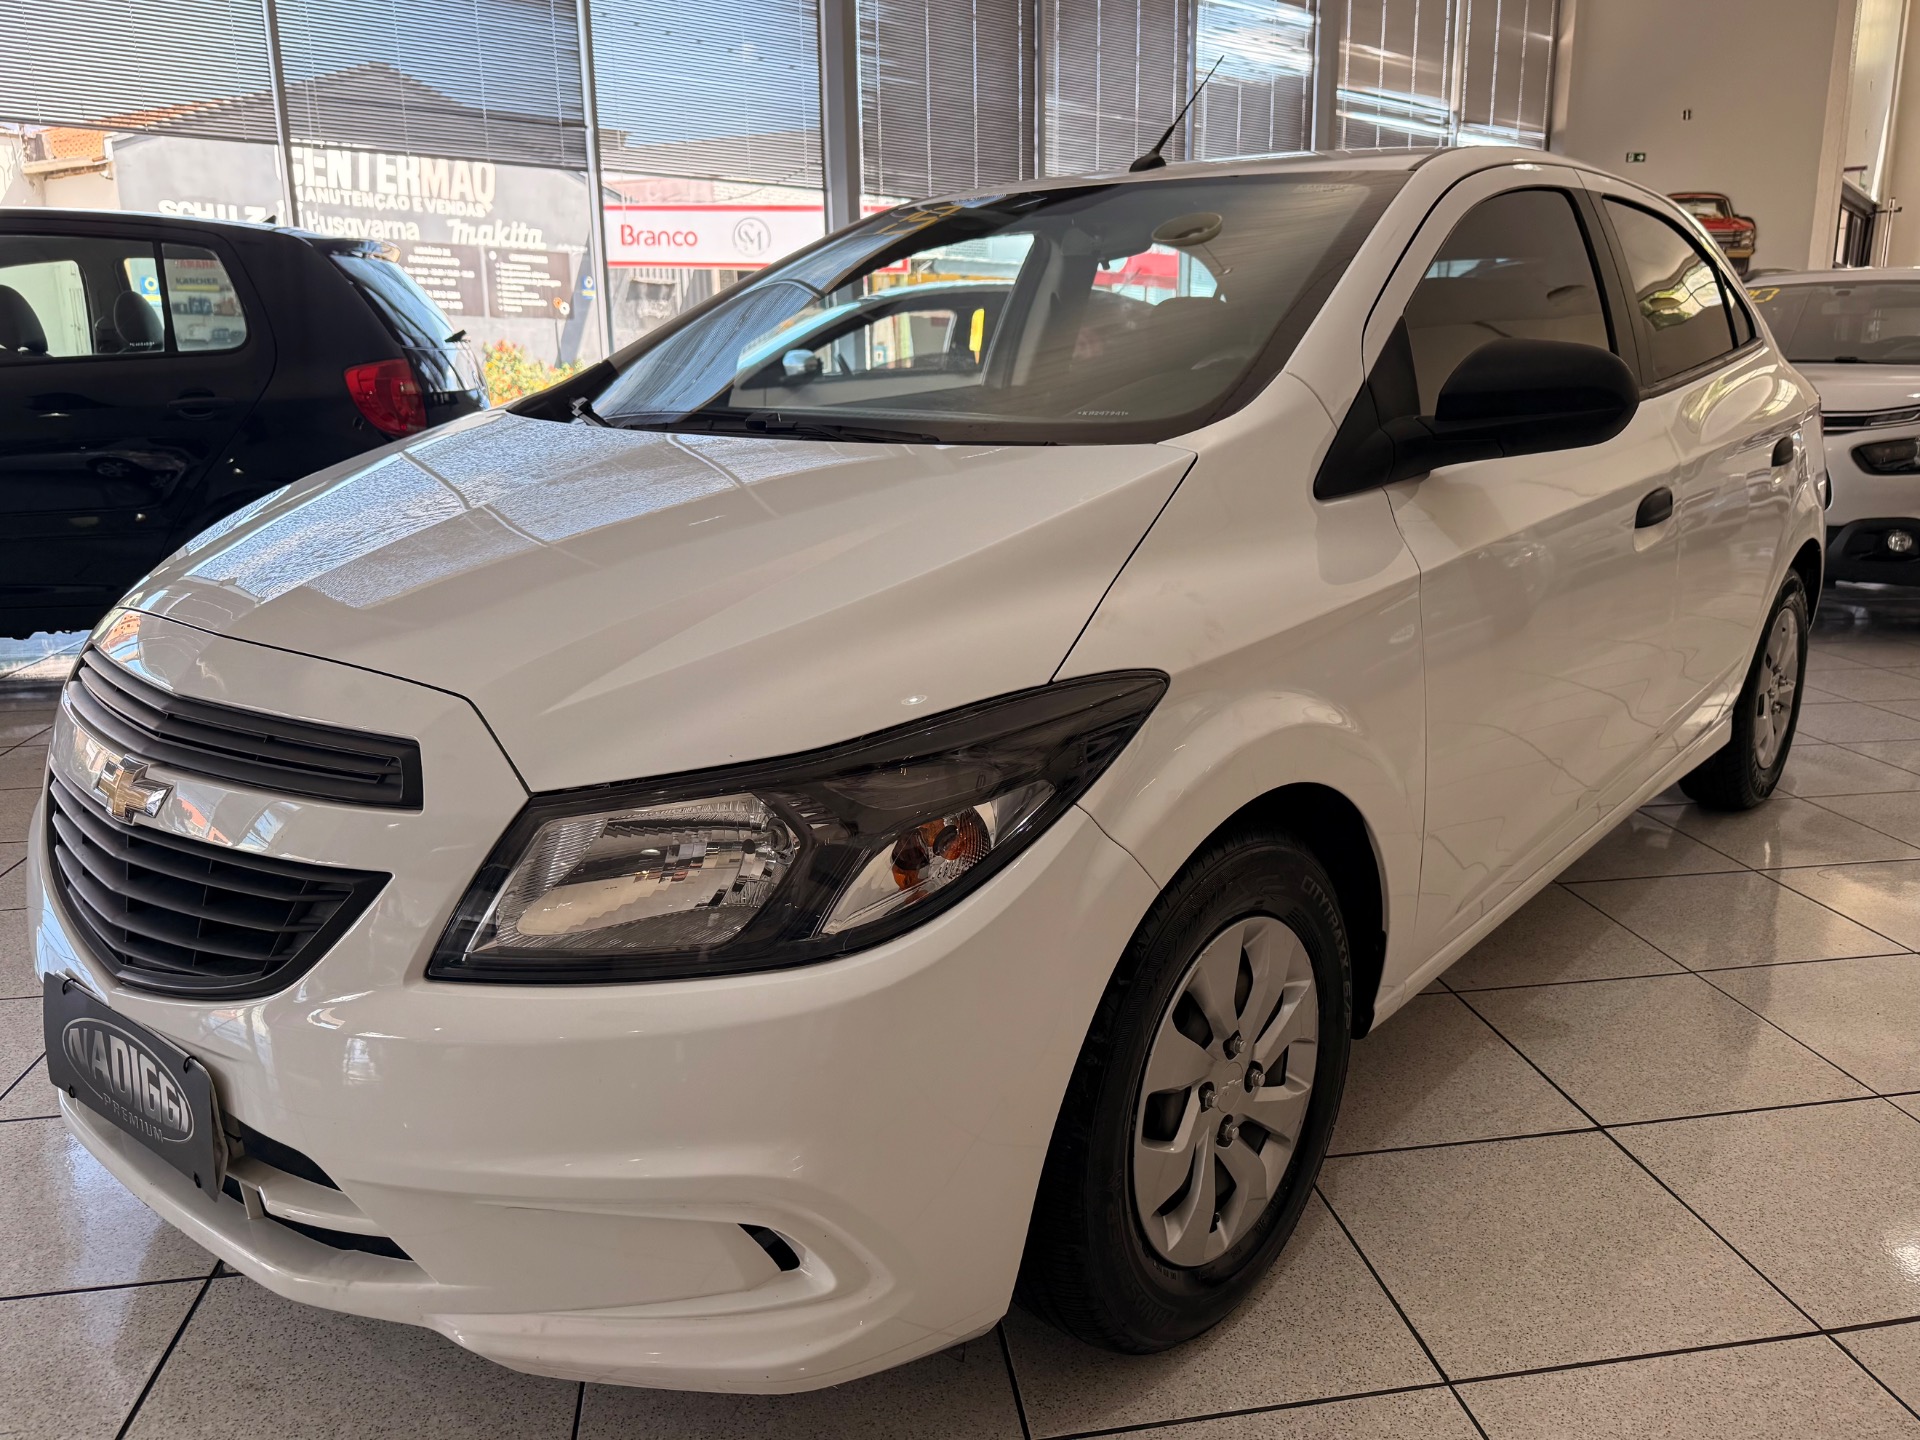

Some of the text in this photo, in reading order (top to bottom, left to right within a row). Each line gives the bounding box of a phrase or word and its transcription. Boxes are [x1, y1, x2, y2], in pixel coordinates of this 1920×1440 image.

[423, 199, 487, 218] VENDAS
[620, 223, 698, 247] Branco
[68, 1027, 190, 1133] NADIGGI
[102, 1092, 165, 1143] PREMIUM
